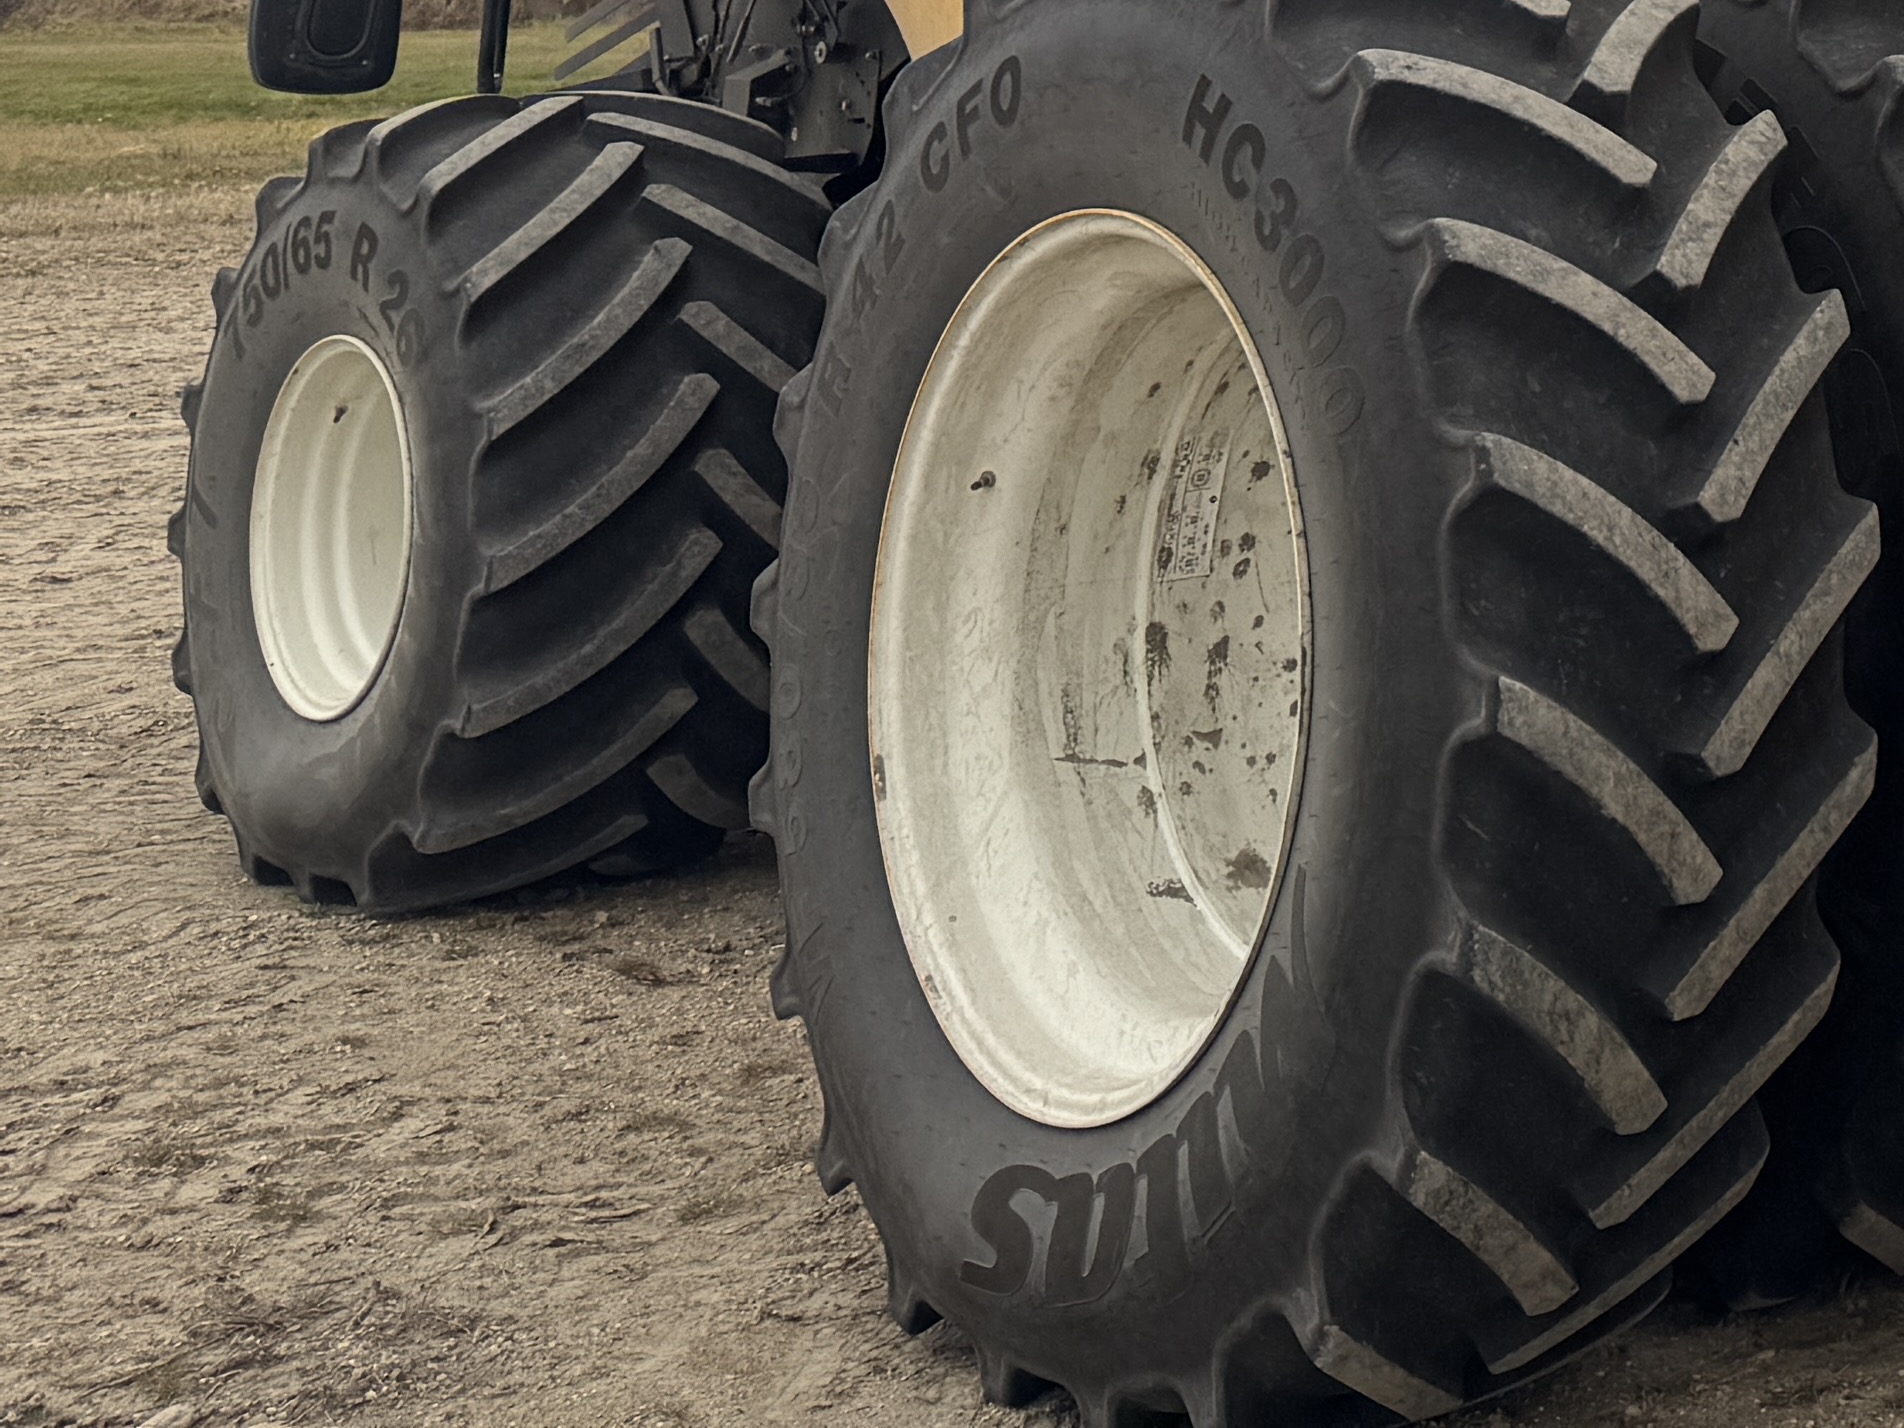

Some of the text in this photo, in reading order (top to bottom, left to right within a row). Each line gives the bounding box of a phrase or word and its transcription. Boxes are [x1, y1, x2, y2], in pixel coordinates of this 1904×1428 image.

[349, 219, 380, 295] R
[918, 53, 1023, 196] CFO
[1180, 72, 1366, 437] HC3000
